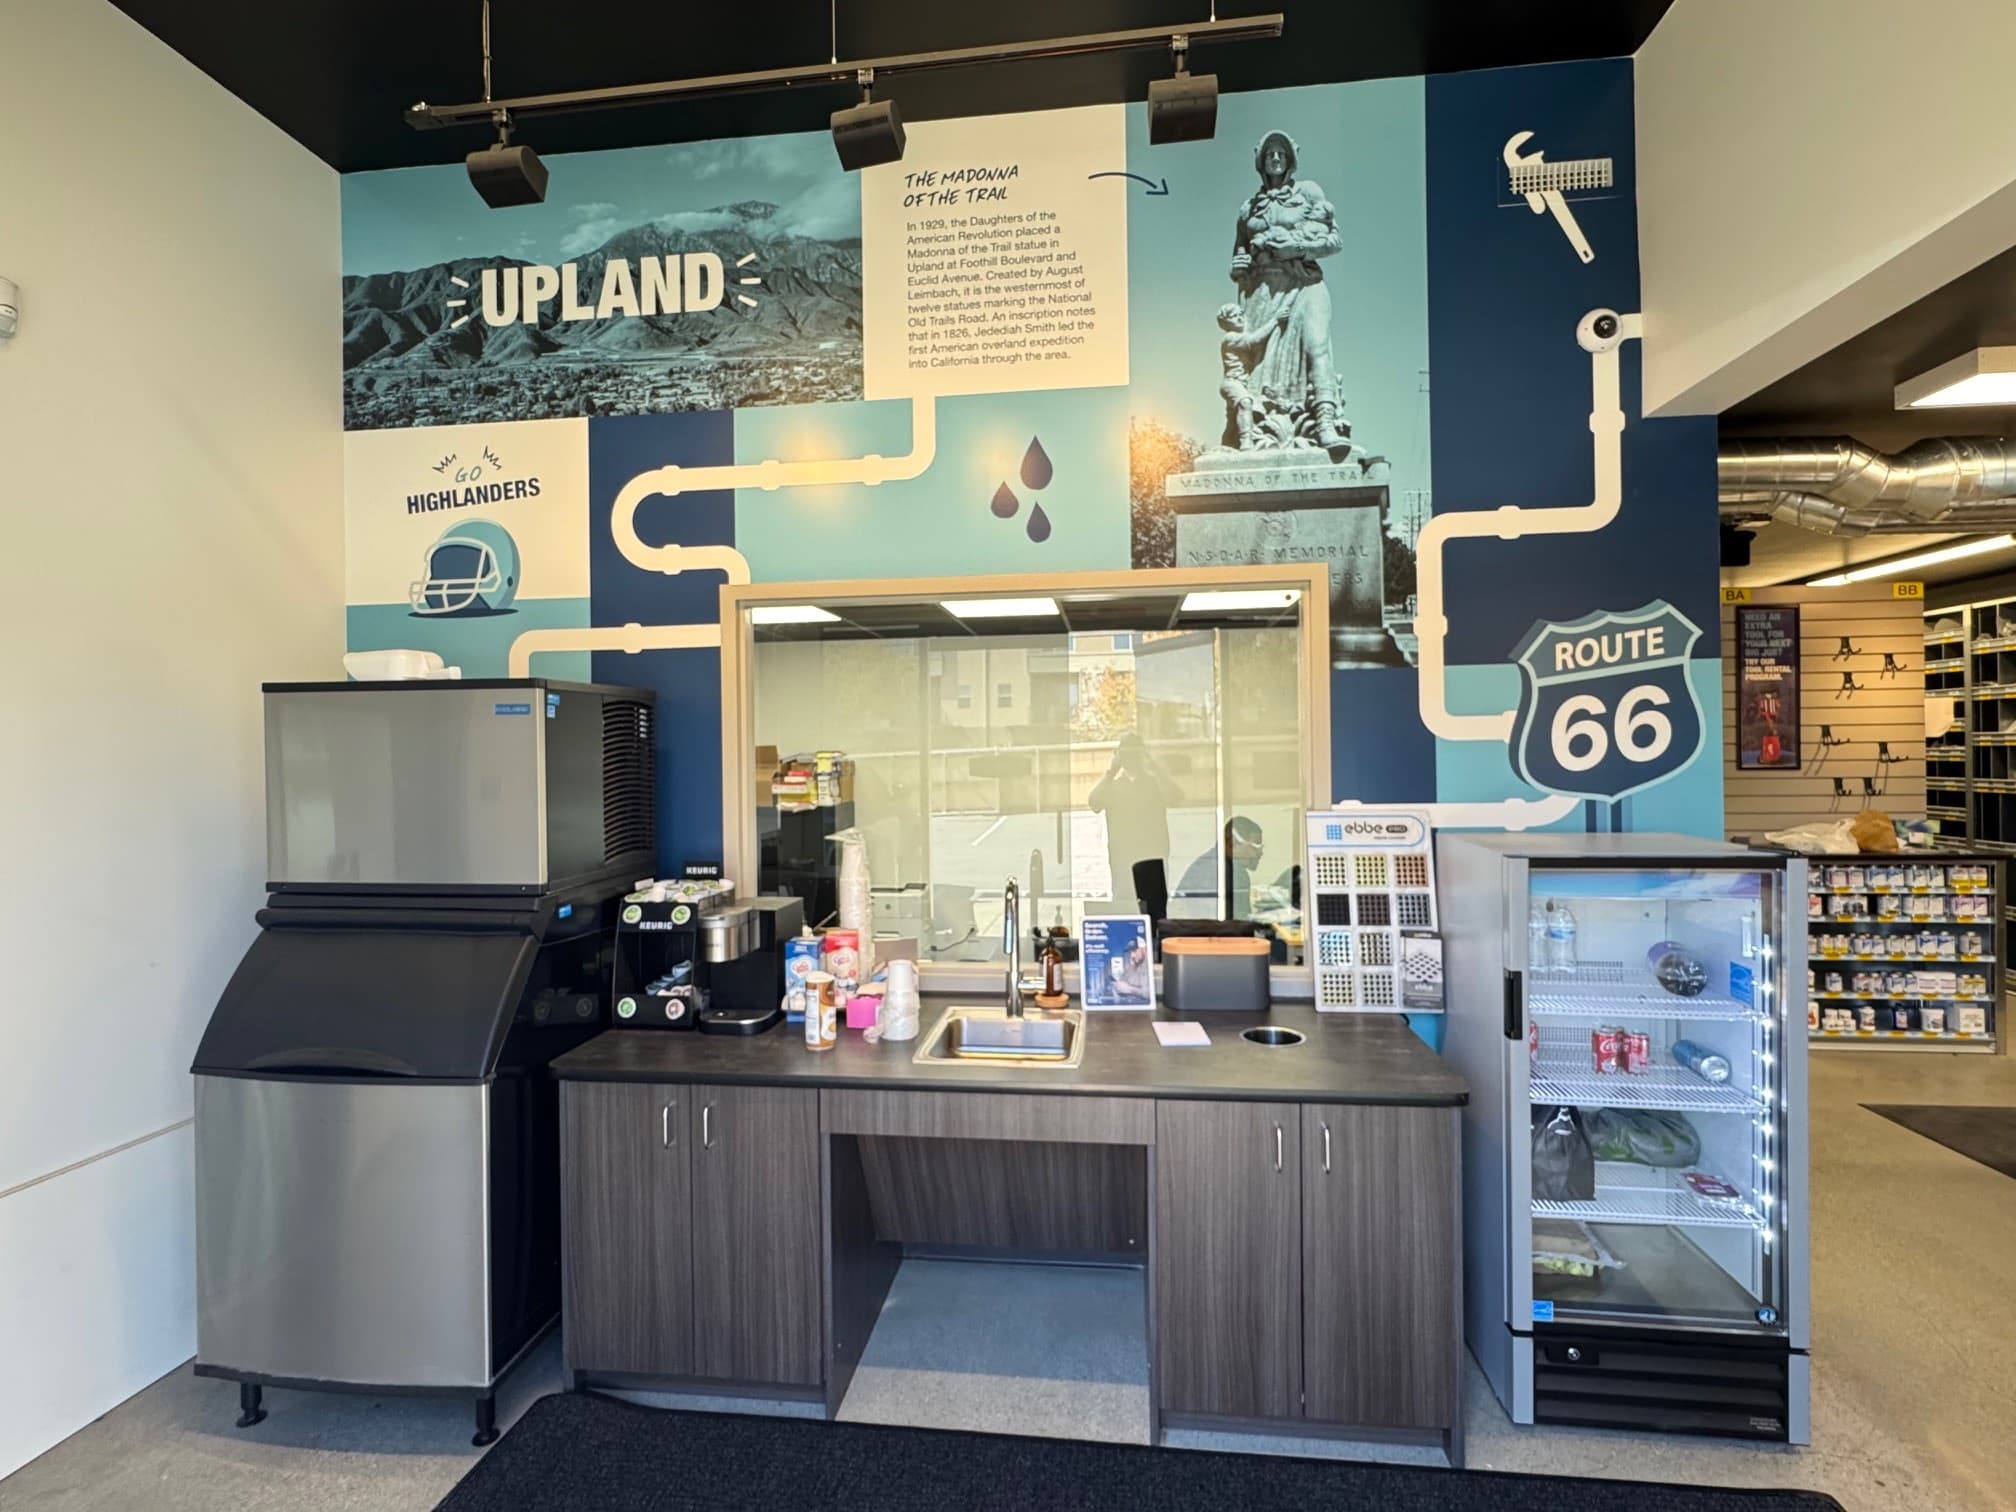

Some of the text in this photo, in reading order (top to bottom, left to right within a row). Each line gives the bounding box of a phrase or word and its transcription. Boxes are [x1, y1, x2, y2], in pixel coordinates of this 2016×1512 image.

[905, 165, 1018, 188] THE MADONNA
[966, 187, 1007, 203] TRAIL
[907, 211, 1056, 231] In 1929, the Daughters of the
[907, 234, 955, 245] American
[959, 230, 1012, 240] Revolution
[1016, 225, 1051, 238] placed
[908, 239, 1059, 258] Madonna of the Trail statue in
[908, 251, 1076, 273] Upland at Foothill Boulevard and
[908, 265, 1083, 286] Euclid Avenue. Created by August
[482, 253, 724, 327] UPLAND
[908, 288, 960, 300] Leimbach,
[963, 288, 970, 296] it
[985, 286, 1001, 294] the
[1004, 280, 1071, 292] westernmost
[1075, 278, 1085, 288] of
[908, 292, 1091, 313] twelve statues marking the National
[908, 307, 1095, 327] Old Trails Road. An inscription notes
[909, 321, 1094, 340] that in 1826, Jedediah Smith led the
[909, 336, 1084, 355] first American overland expedition
[909, 352, 1071, 368] into California through the area.
[455, 466, 482, 482] GO
[1181, 477, 1254, 488] MADONNA
[1265, 475, 1280, 485] OF
[1293, 473, 1317, 482] THE
[407, 478, 540, 514] HIGHLANDERS
[1275, 546, 1369, 560] MEMORIAL
[1726, 591, 1744, 600] BA
[1898, 585, 1918, 595] BB
[1555, 626, 1664, 671] ROUTE
[1551, 685, 1672, 771] 66
[1345, 821, 1382, 833] ebbe
[640, 921, 672, 929] KEURIG
